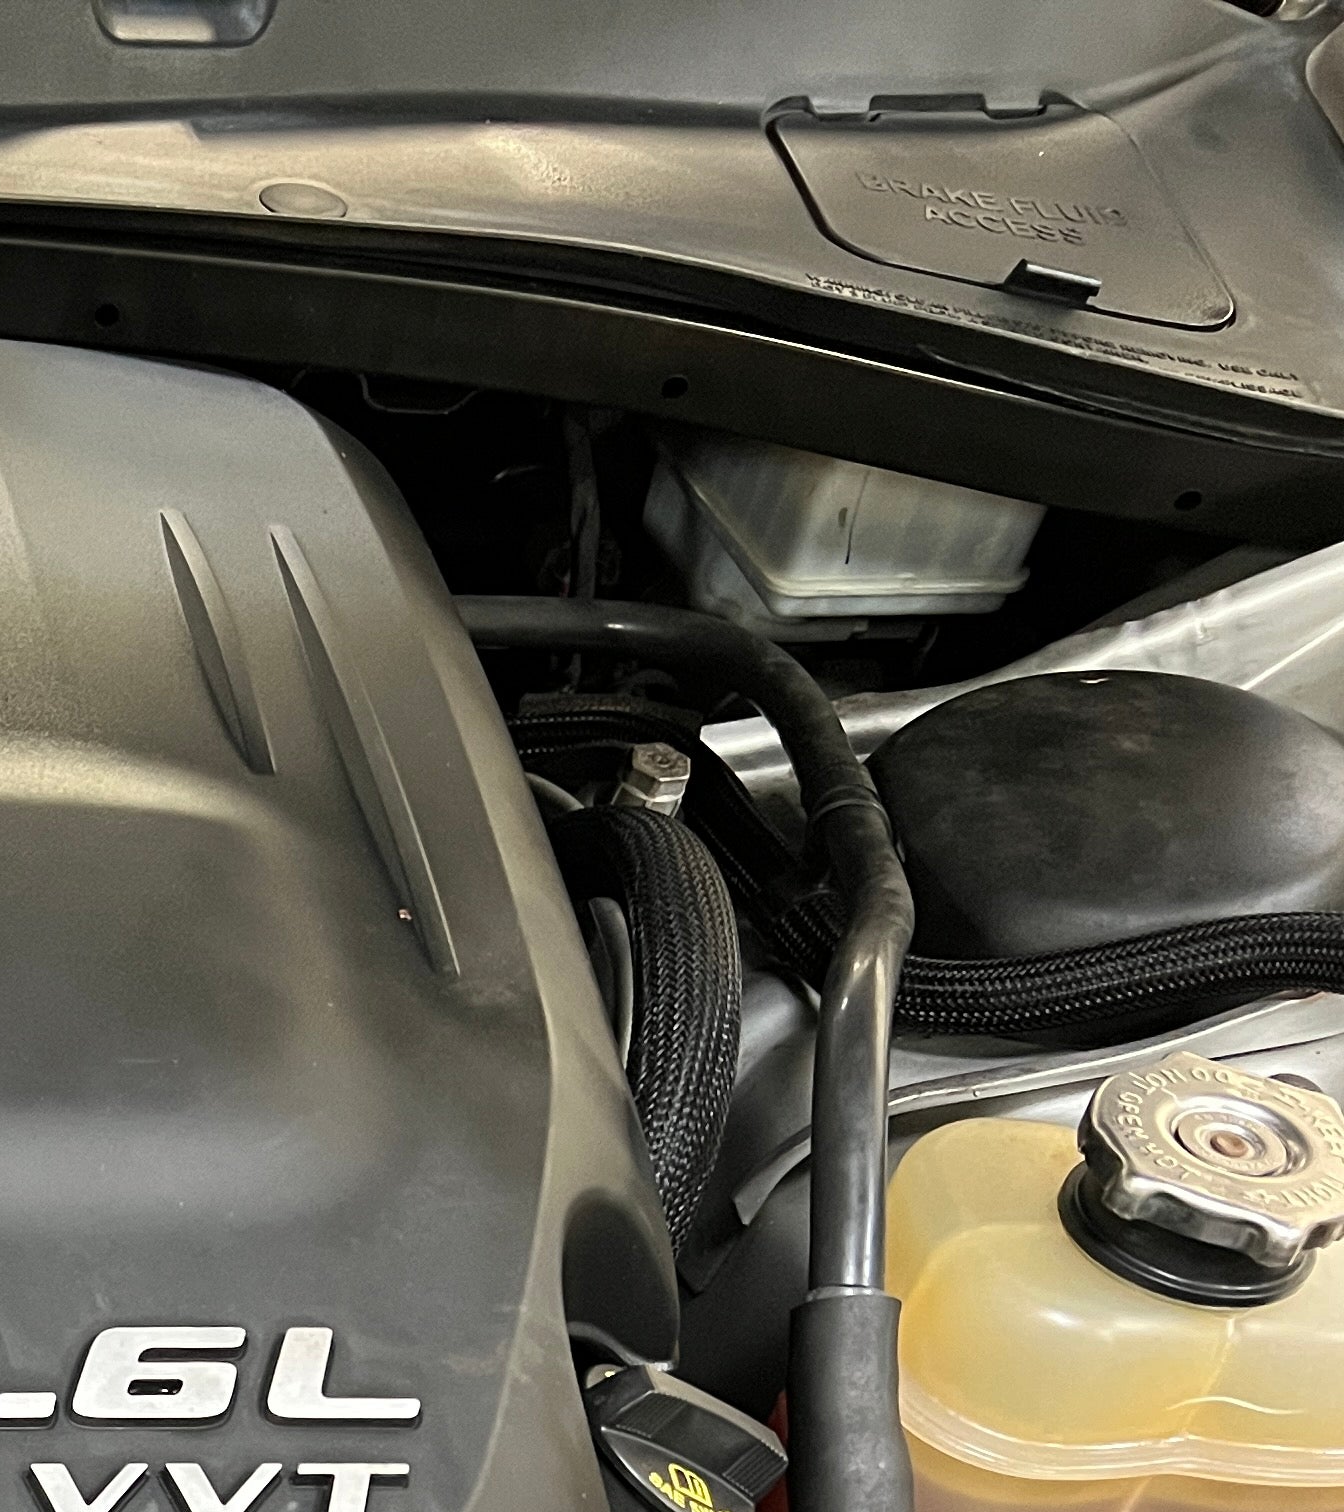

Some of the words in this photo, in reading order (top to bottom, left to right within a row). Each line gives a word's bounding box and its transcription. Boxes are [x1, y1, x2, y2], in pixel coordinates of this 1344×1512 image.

[855, 171, 1004, 212] BRAKE
[1009, 197, 1128, 226] FLUID
[924, 204, 1087, 246] ACCESS
[648, 1471, 686, 1508] SAE
